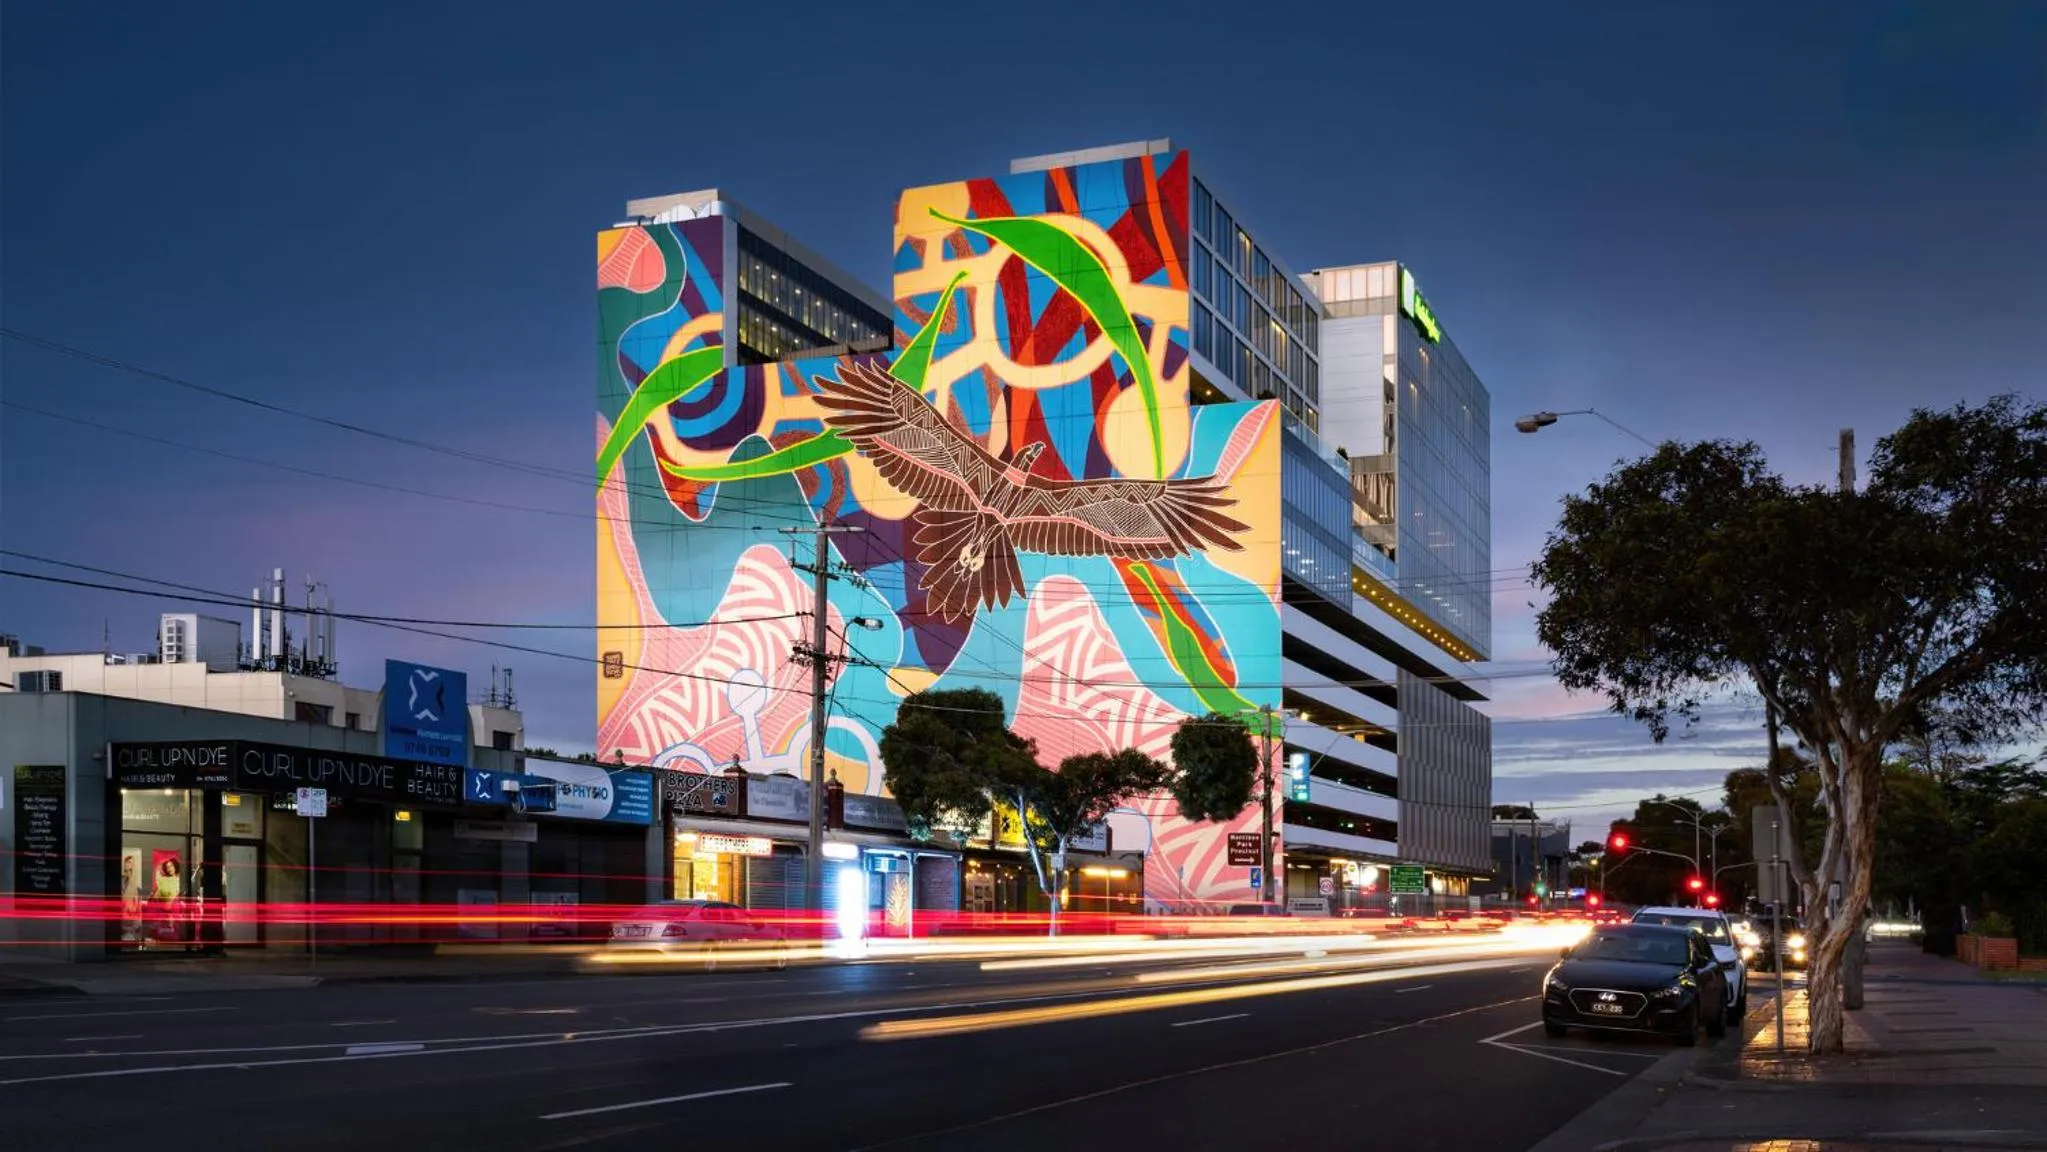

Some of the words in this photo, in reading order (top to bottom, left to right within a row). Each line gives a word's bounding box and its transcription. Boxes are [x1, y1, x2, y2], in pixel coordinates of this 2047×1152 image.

[118, 747, 160, 767] CURL
[198, 745, 228, 766] DYE
[146, 773, 176, 783] BEAUTY
[242, 749, 304, 780] CURL
[307, 756, 354, 785] UP'N
[358, 762, 395, 790] DYE
[415, 762, 444, 780] HAIR
[448, 767, 457, 782] &
[407, 778, 457, 797] BEAUTY
[668, 773, 736, 794] BROTHERS
[665, 789, 703, 808] PIZZA
